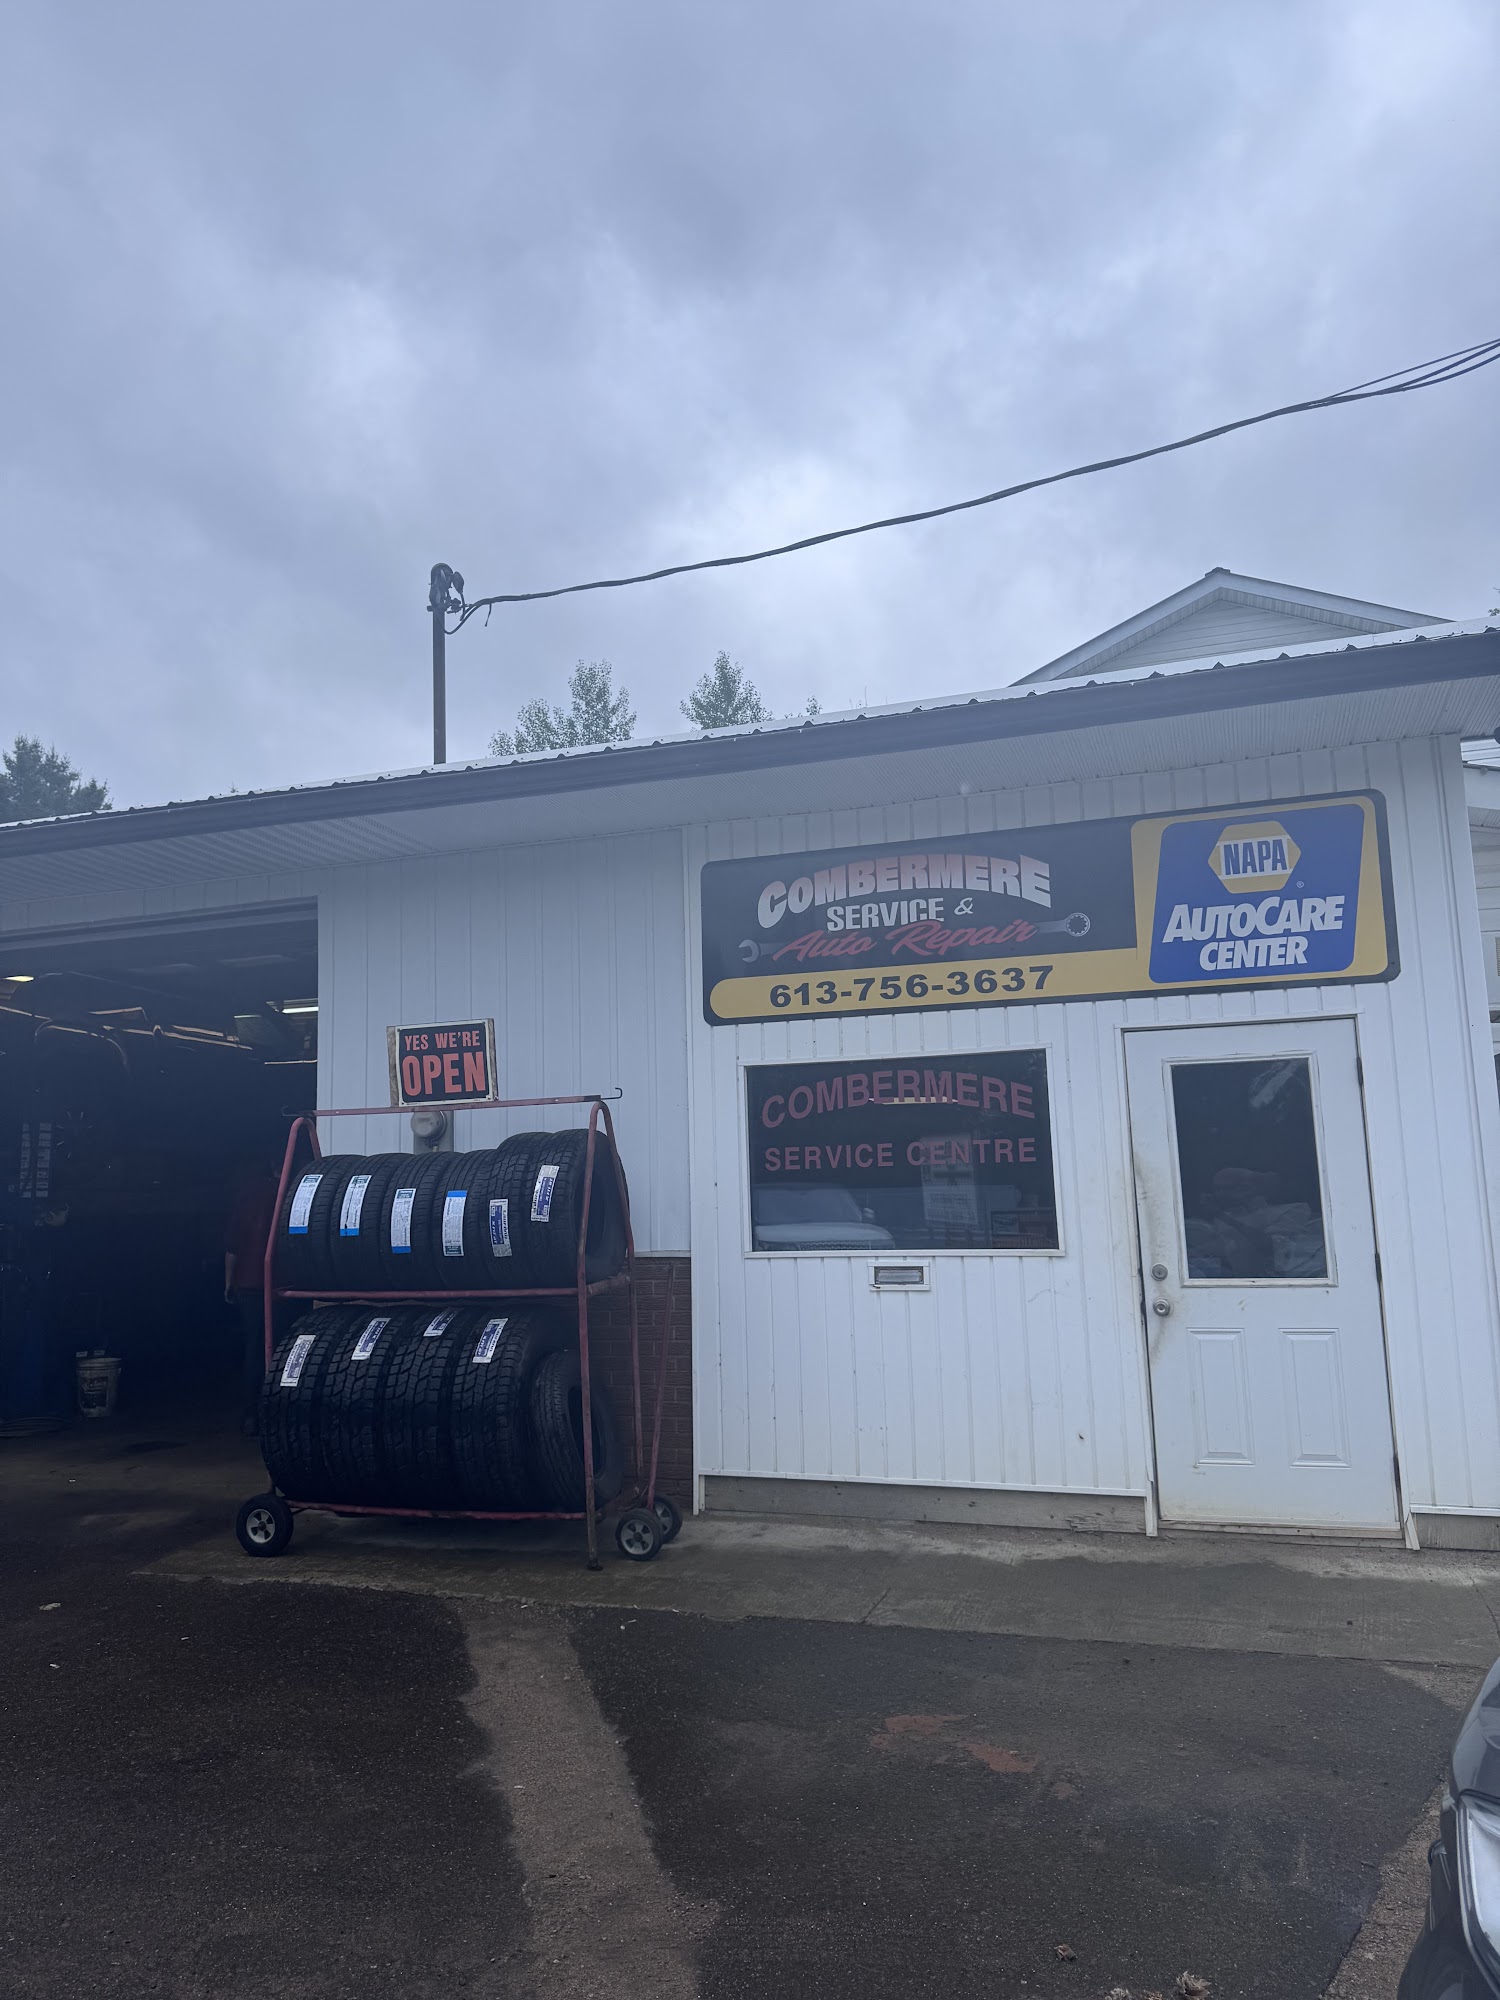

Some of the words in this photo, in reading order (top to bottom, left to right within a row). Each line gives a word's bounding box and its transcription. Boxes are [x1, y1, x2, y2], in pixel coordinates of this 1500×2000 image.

[1223, 838, 1288, 876] NAPA
[757, 854, 1052, 929] COMBERMERE
[826, 897, 945, 932] SERVICE
[953, 897, 974, 915] &
[772, 930, 877, 961] Auto
[885, 918, 1039, 956] Repair
[1199, 935, 1309, 971] CENTER
[769, 965, 1054, 1008] 613-756-3637
[404, 1034, 429, 1051] YES
[434, 1030, 480, 1049] WE'RE
[402, 1051, 486, 1097] OPEN
[761, 1069, 1035, 1128] COMBERMERE
[765, 1142, 894, 1172] SERVICE
[906, 1137, 1037, 1166] CENTRE
